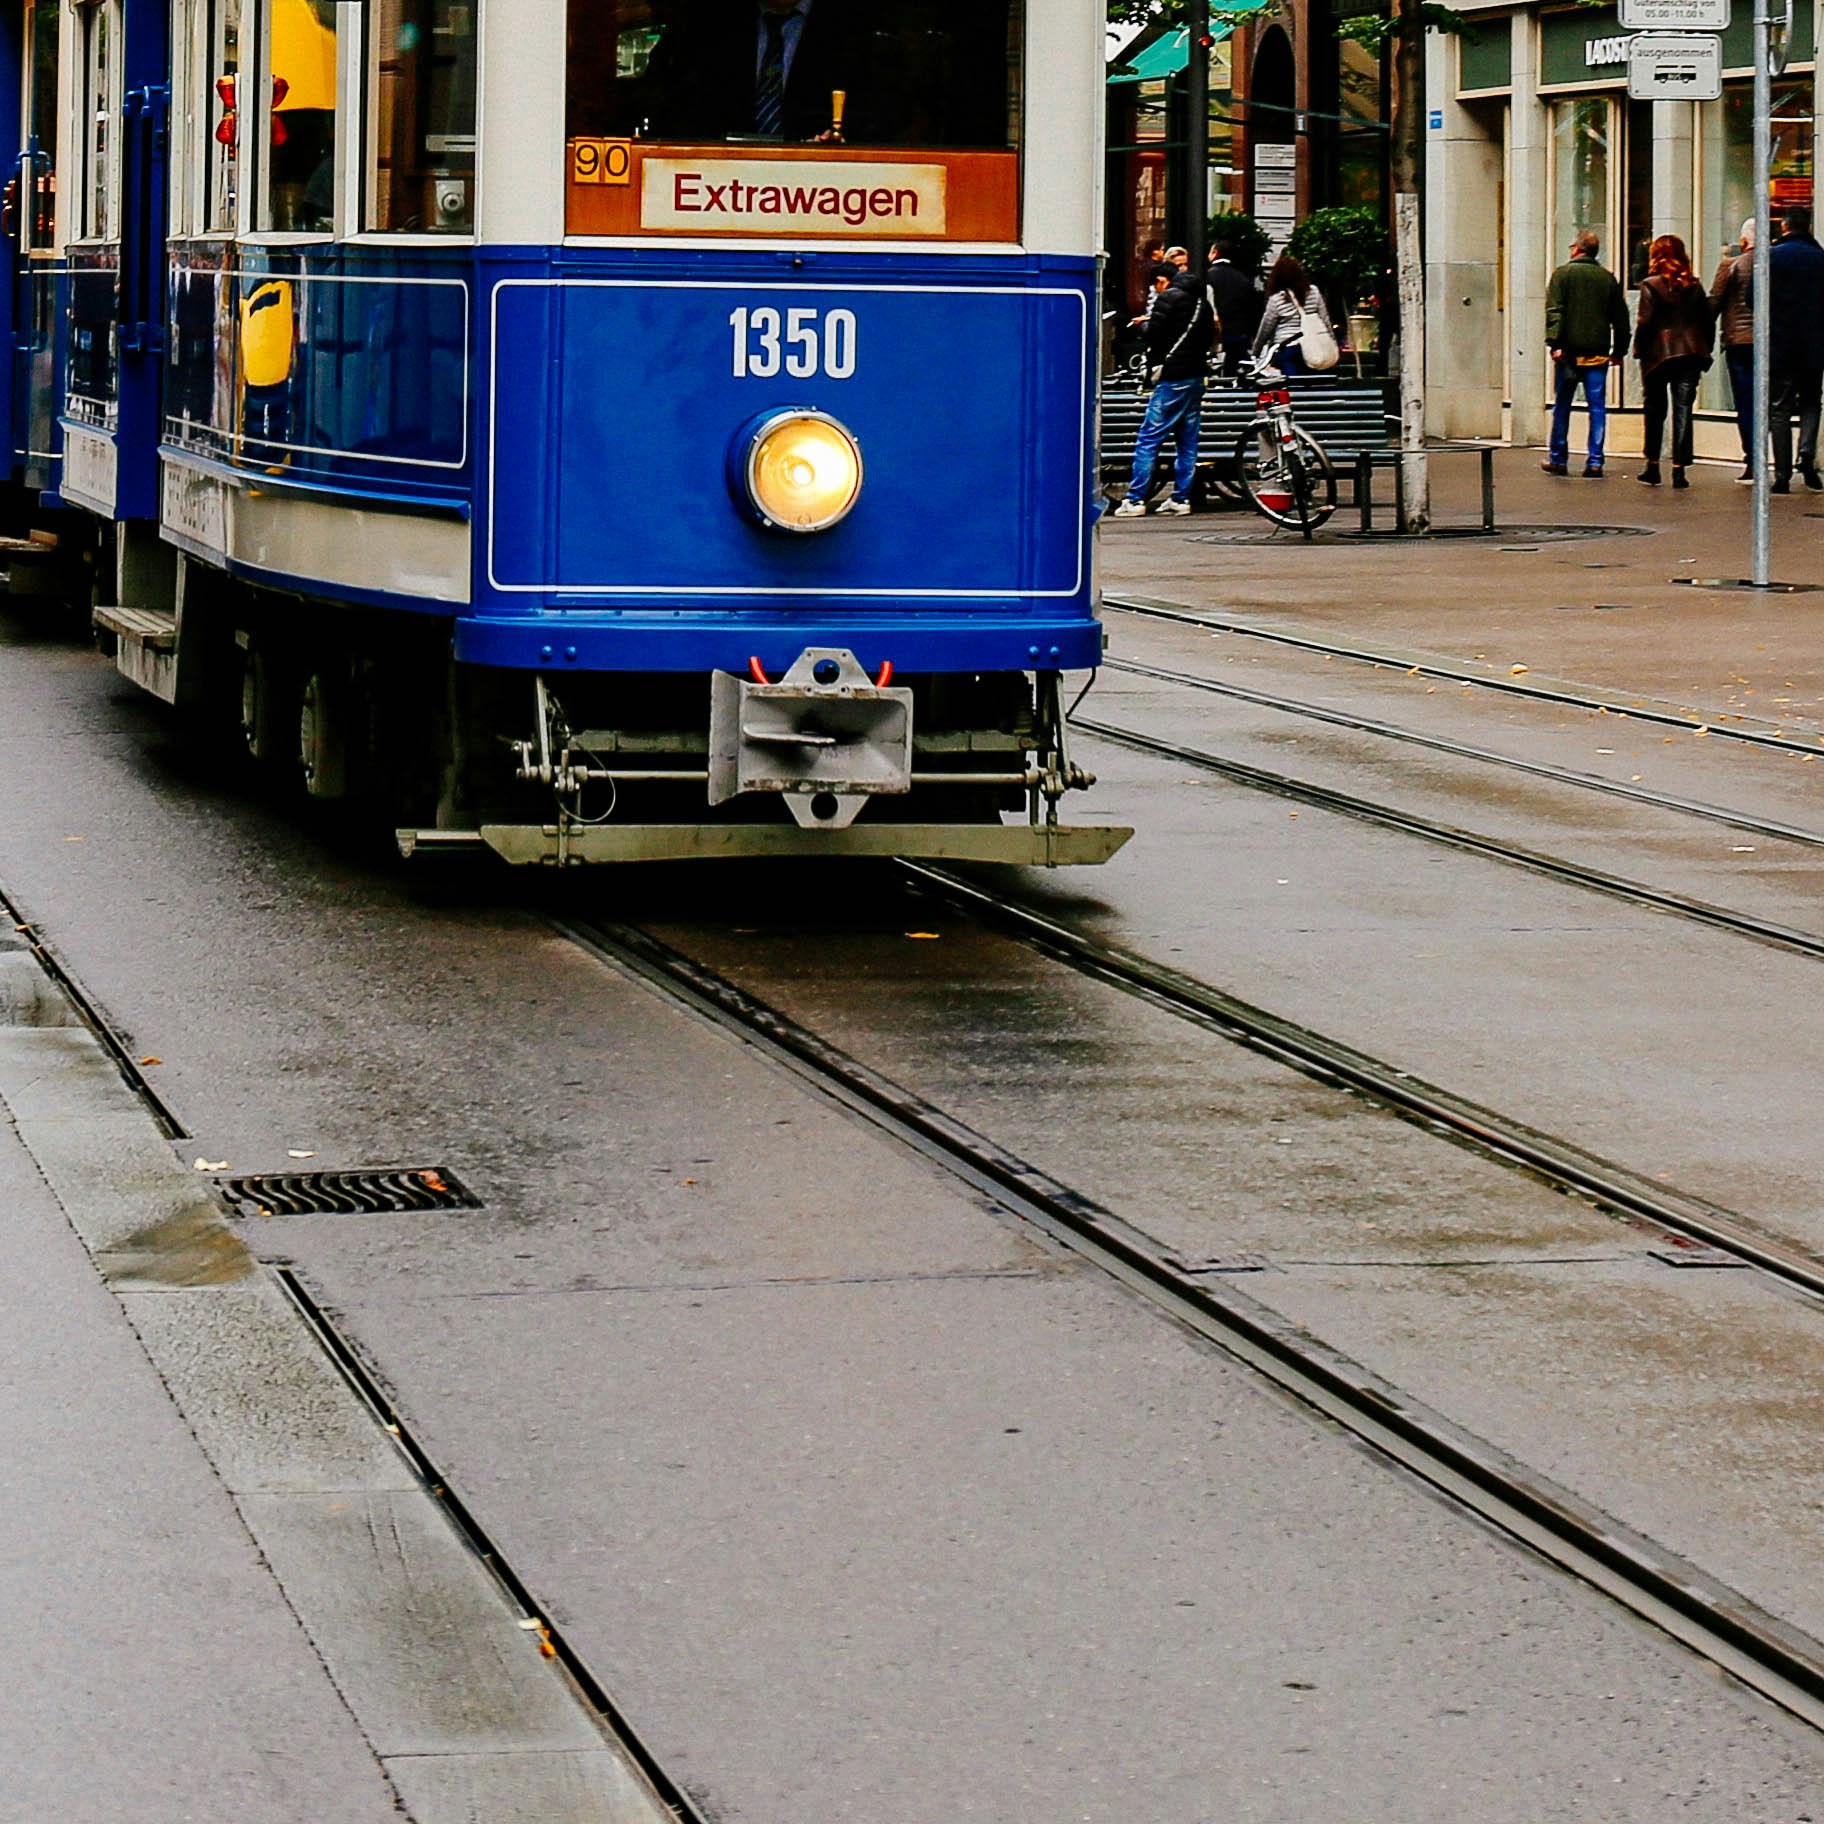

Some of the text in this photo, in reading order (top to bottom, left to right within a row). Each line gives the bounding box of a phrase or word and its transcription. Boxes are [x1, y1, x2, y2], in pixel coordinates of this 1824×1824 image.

[1586, 37, 1633, 66] LACOST
[1637, 49, 1713, 60] ausgenommen
[575, 143, 629, 177] 90
[674, 173, 919, 225] Extrawagen
[729, 306, 857, 379] 1350
